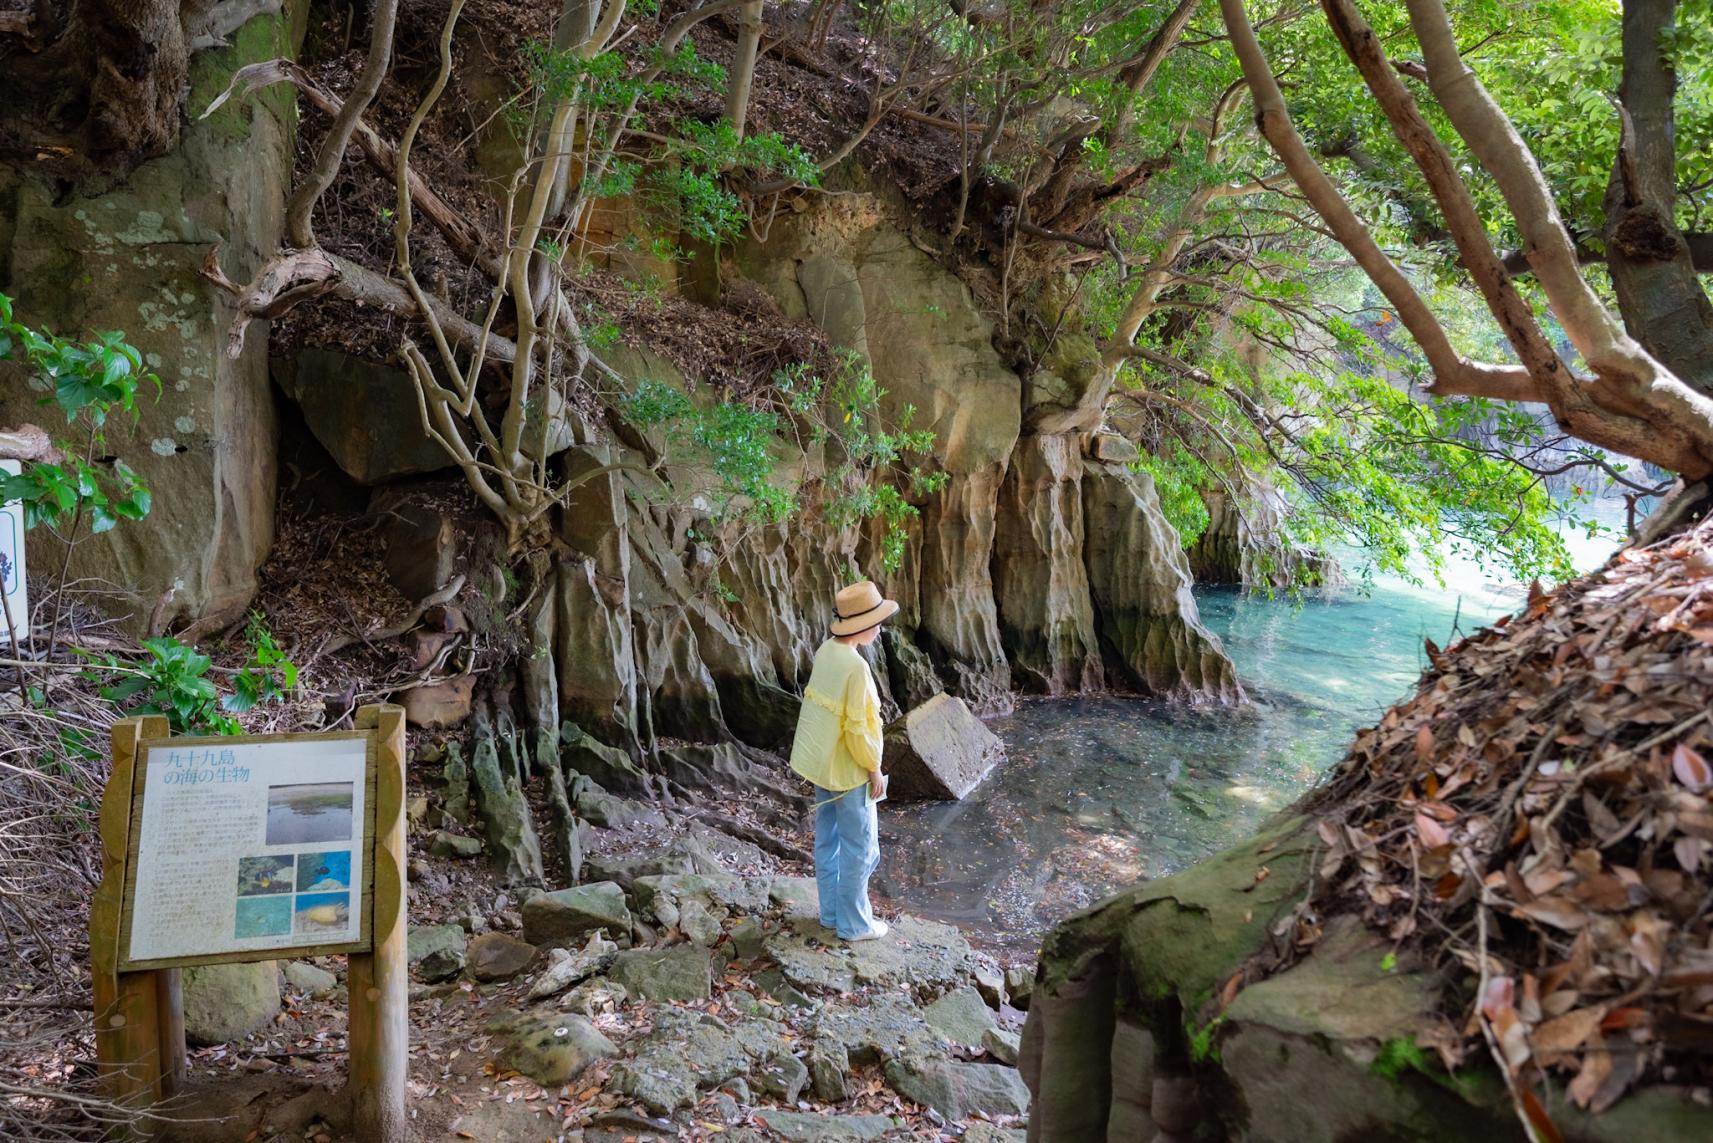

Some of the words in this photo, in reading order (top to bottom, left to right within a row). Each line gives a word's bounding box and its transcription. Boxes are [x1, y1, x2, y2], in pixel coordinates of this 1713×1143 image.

[164, 749, 235, 768] 九十九島
[164, 766, 250, 785] の海の生物
